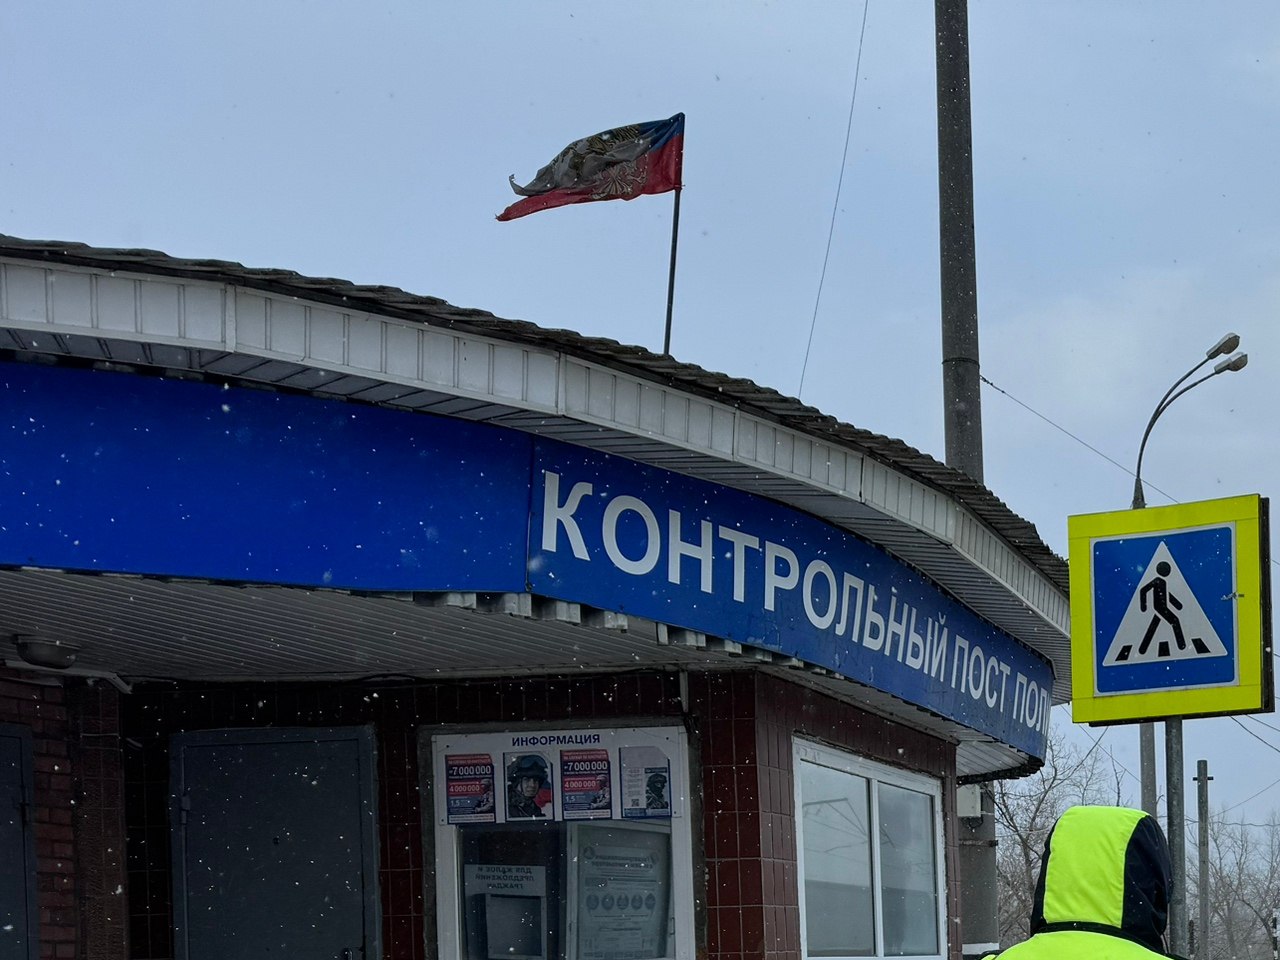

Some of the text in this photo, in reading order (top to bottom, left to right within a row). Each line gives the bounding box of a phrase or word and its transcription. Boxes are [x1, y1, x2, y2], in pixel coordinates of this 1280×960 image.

[541, 470, 948, 682] КОНТРОЛЬНЫЙ
[951, 634, 1011, 712] ПОСТ
[511, 733, 600, 747] ИНФОРМАЦИЯ
